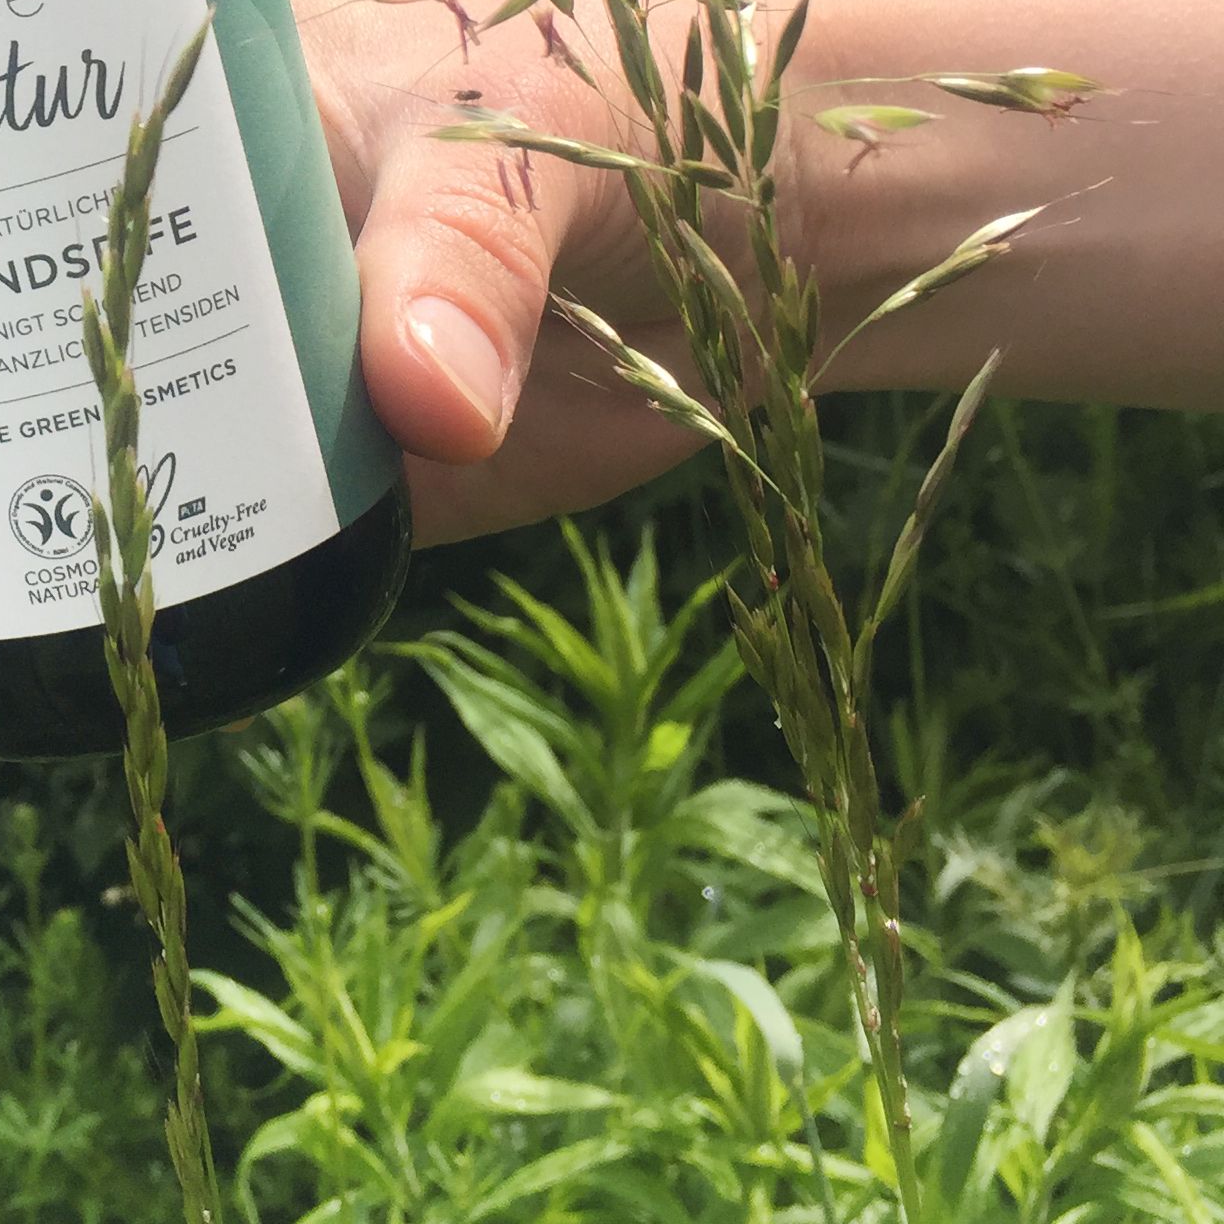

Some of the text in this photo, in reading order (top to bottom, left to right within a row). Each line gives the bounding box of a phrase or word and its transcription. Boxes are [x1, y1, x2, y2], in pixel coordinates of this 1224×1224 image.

[55, 273, 183, 327] SCEND
[134, 284, 241, 339] TENSIDEN
[19, 404, 102, 439] GREEN
[134, 358, 238, 408] SMETICS
[171, 498, 267, 544] Cruelty-Free
[176, 526, 255, 565] and Vegan
[24, 559, 98, 586] COSMO
[28, 577, 101, 605] NATURA
